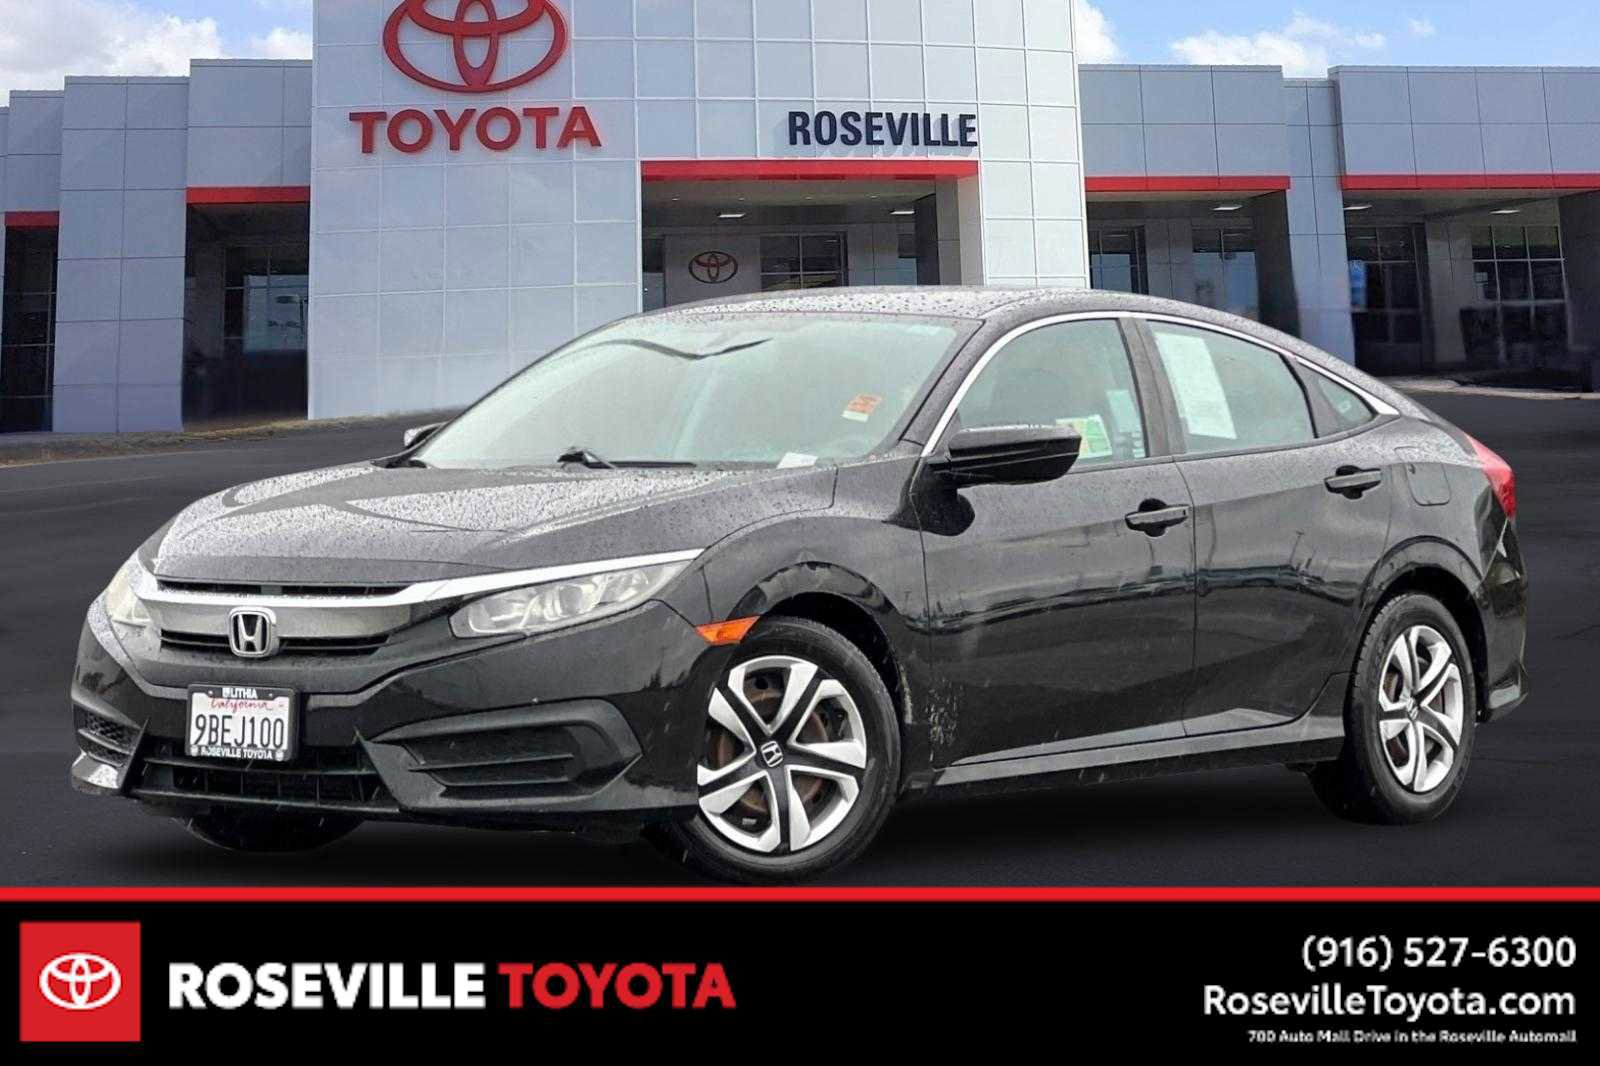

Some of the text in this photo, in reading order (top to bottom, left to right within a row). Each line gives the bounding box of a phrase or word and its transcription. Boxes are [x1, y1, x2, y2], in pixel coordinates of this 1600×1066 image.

[349, 106, 602, 154] TOYOTA
[788, 110, 979, 148] ROSEVILLE
[230, 687, 258, 699] LITHIA
[194, 713, 284, 748] 9BEJ100
[200, 746, 273, 760] ROSEVILLE TOYOTA
